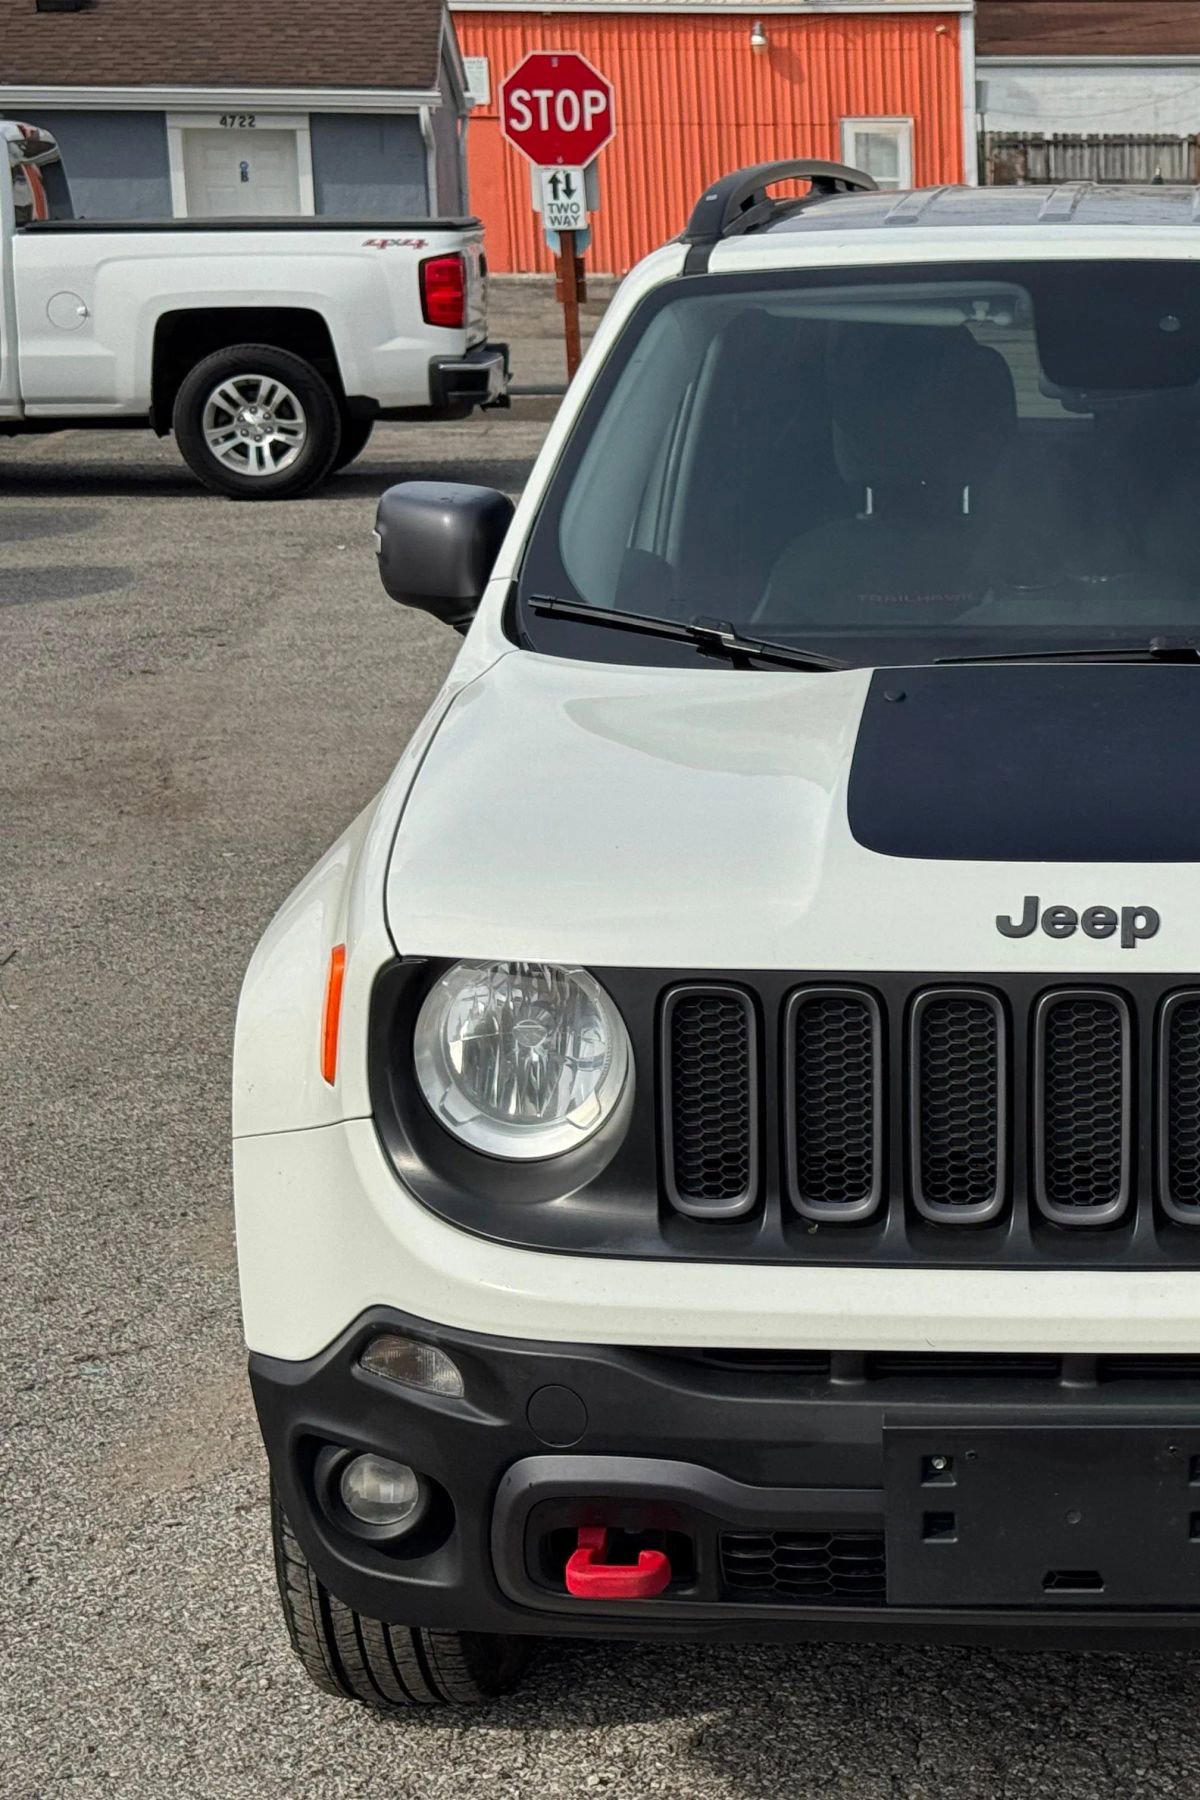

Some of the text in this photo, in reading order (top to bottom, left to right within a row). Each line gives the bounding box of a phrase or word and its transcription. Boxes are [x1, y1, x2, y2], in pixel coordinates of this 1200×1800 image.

[509, 88, 607, 132] STOP
[219, 115, 256, 128] 4722
[548, 202, 581, 214] TWO
[549, 214, 581, 227] WAY
[995, 895, 1161, 949] Jeep
